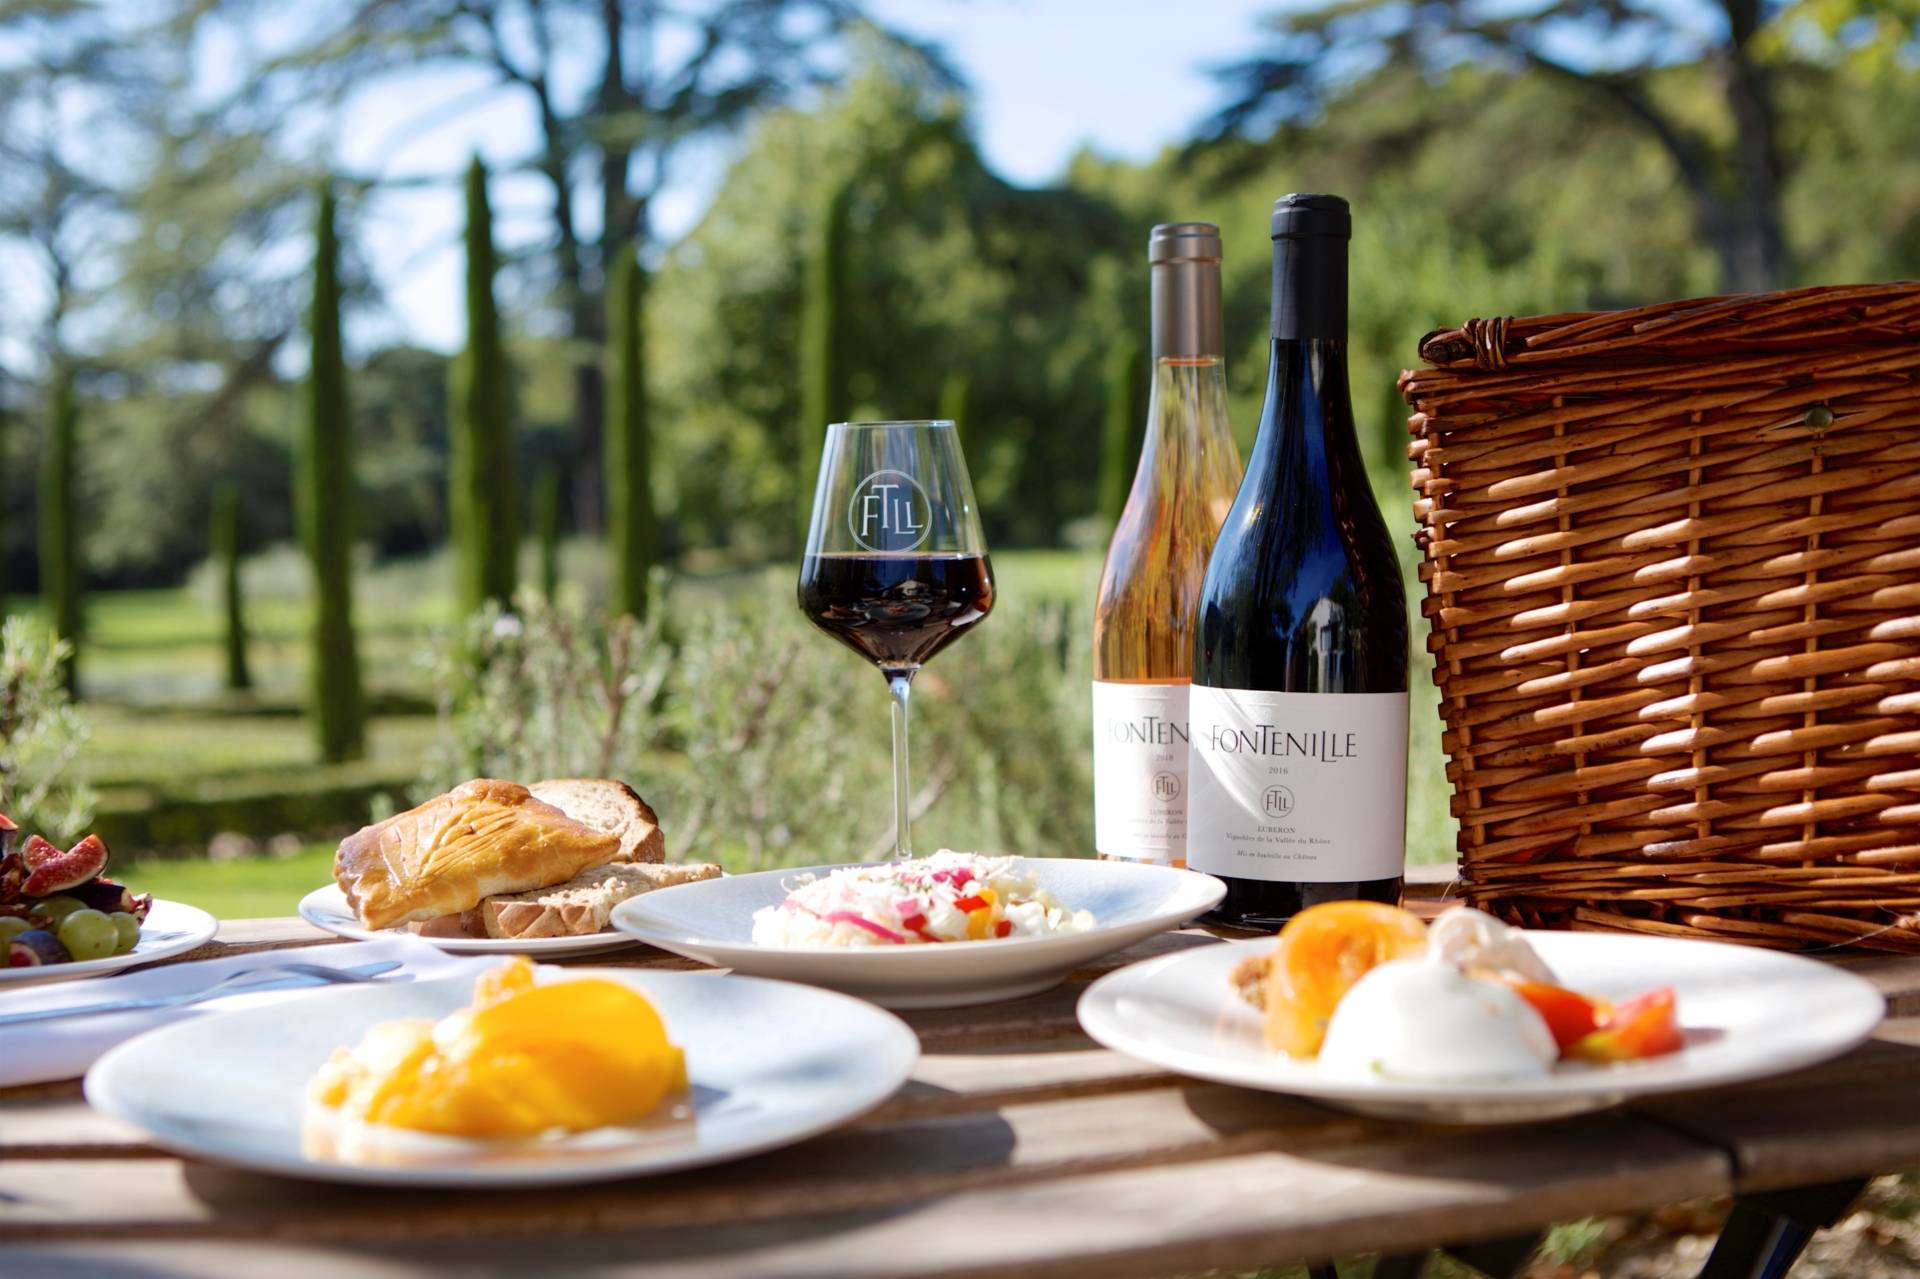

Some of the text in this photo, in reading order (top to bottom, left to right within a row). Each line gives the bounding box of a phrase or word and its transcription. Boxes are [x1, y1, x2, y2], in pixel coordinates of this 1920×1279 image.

[1212, 724, 1358, 763] FONTENILLE
[1268, 766, 1289, 775] 2016
[1257, 826, 1296, 834] LUBERON
